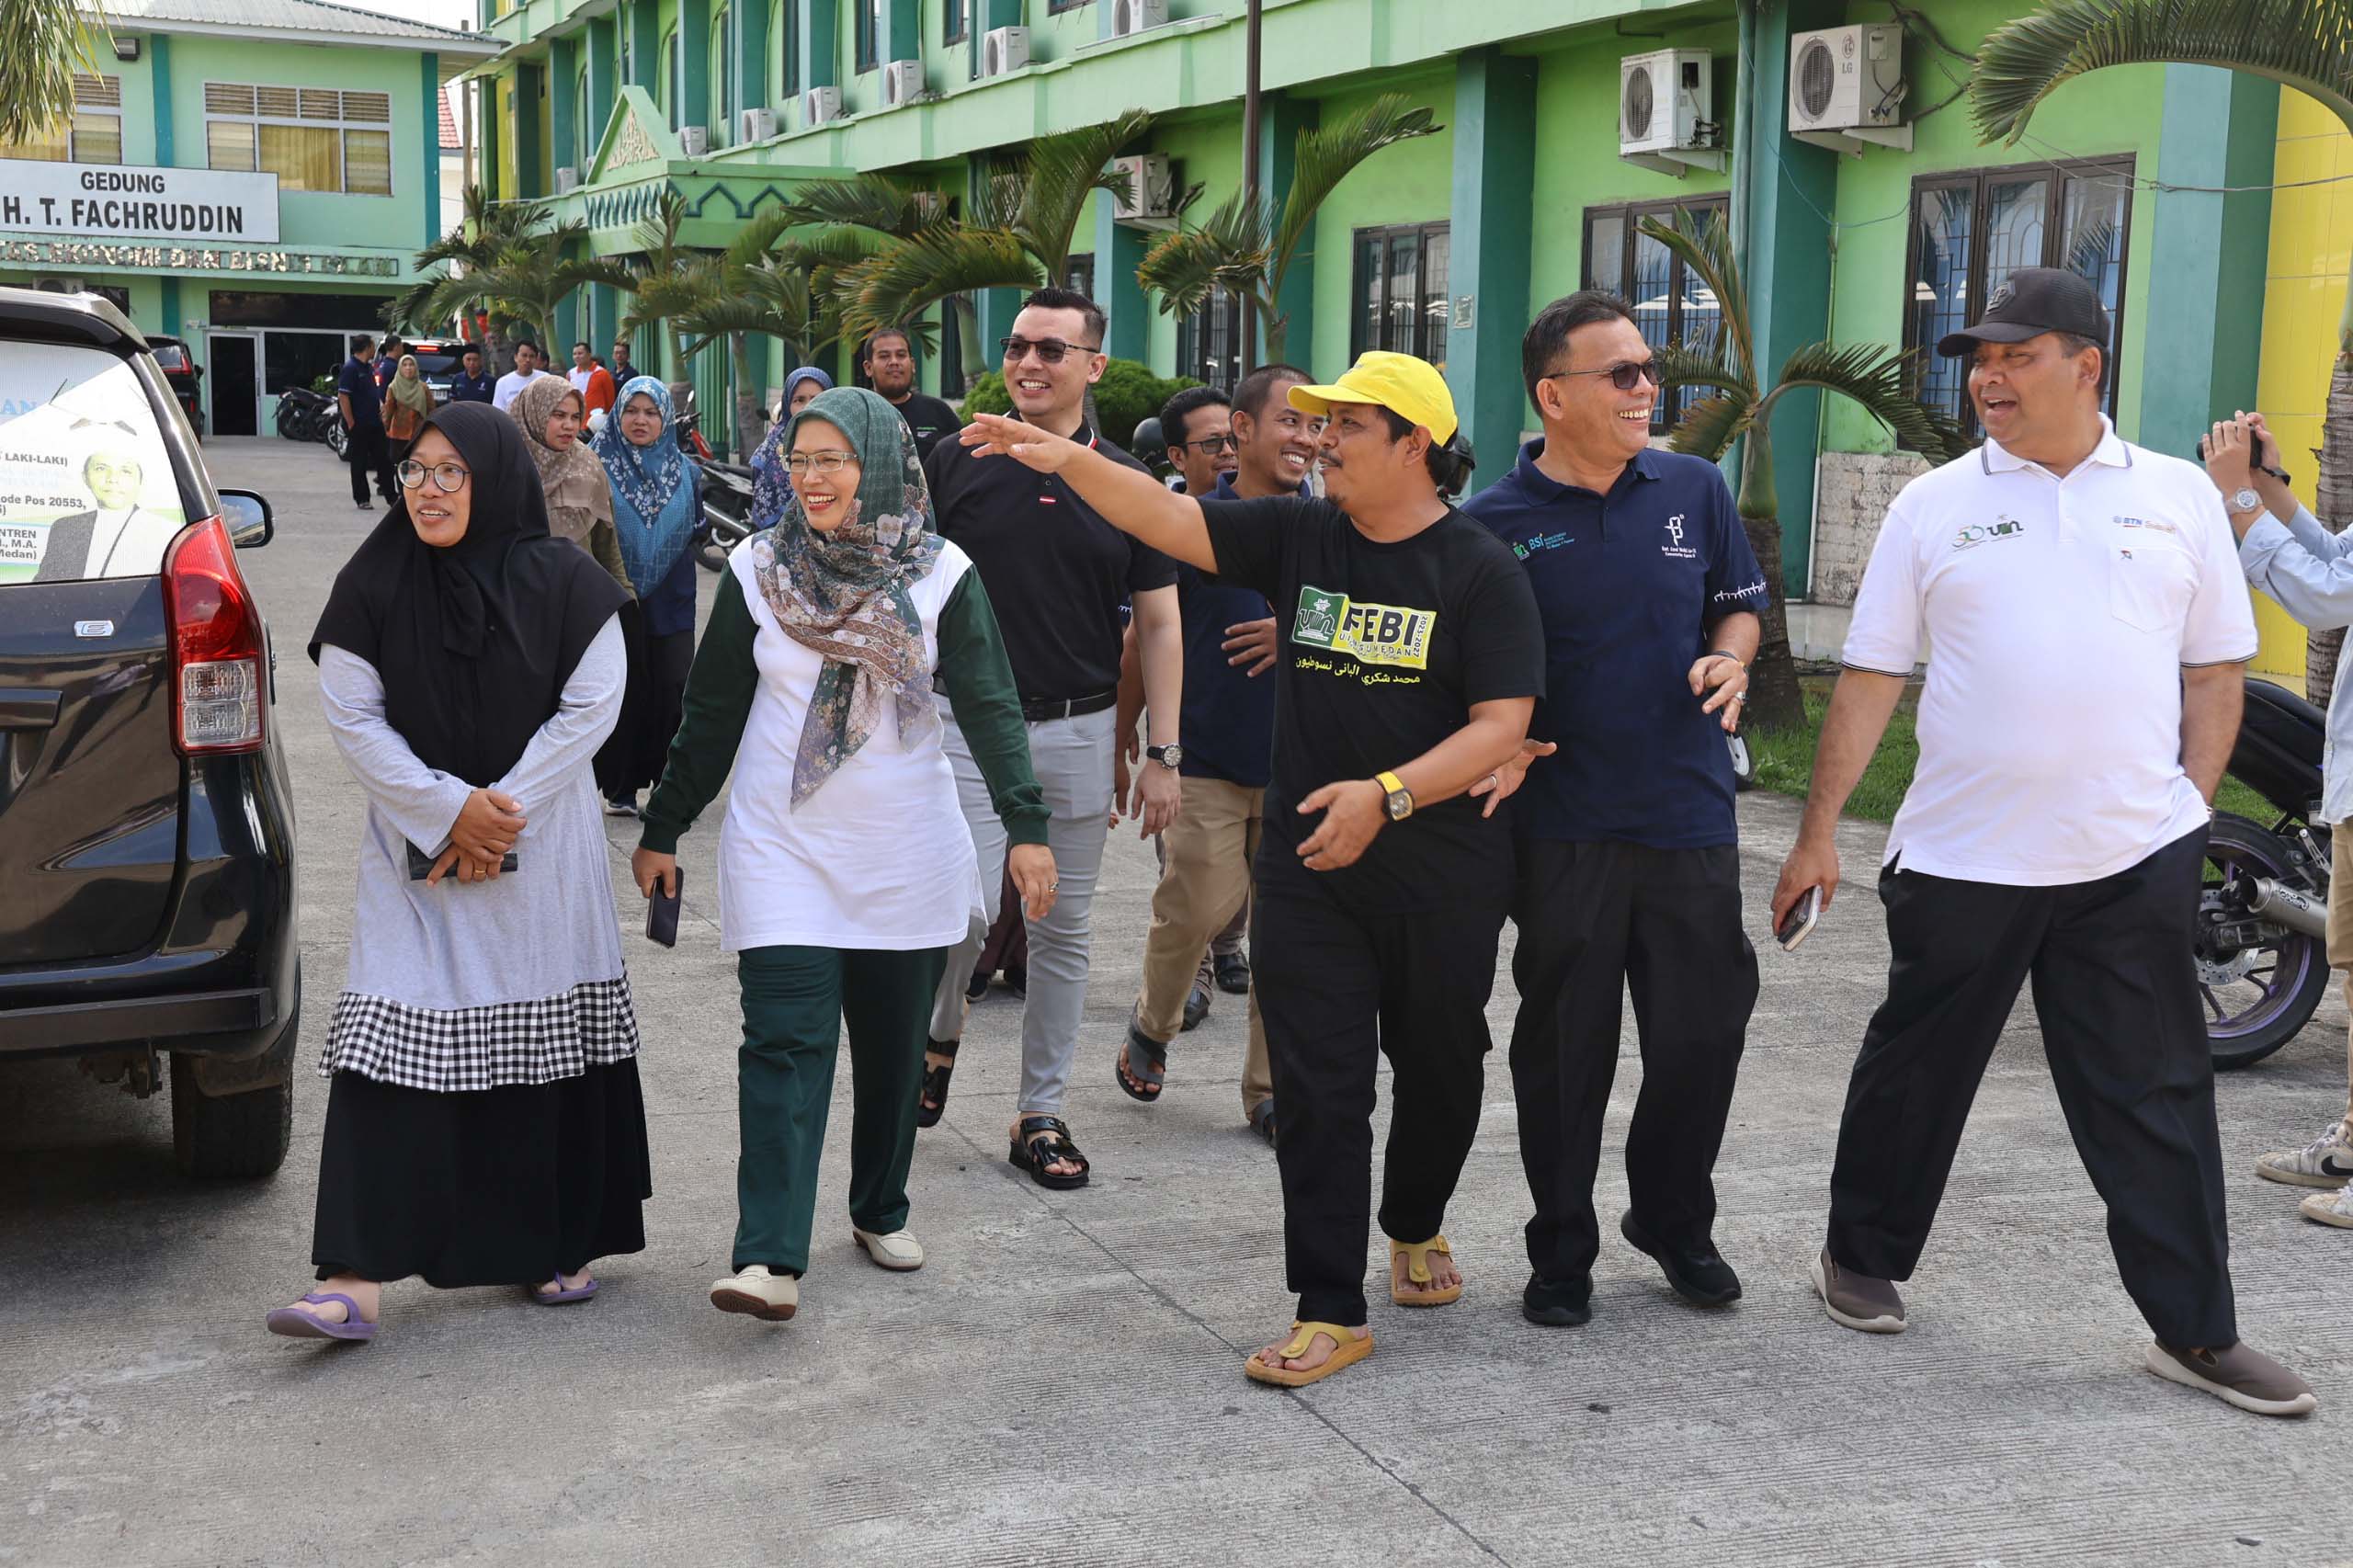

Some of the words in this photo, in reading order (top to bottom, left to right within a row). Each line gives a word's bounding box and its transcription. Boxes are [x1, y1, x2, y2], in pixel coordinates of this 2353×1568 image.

[81, 171, 165, 194] GEDUNG
[3, 196, 30, 224] H.
[40, 198, 62, 226] T.
[72, 199, 243, 233] FACHRUDDIN
[49, 243, 161, 268] EKONOMI
[170, 247, 221, 270] DAN
[6, 452, 68, 467] LAKI-LAKI)
[25, 495, 45, 506] Pos
[49, 497, 86, 510] 20553,
[11, 540, 37, 549] M.A.
[1343, 608, 1419, 646] FEBI
[1413, 616, 1428, 658] 2023-2027
